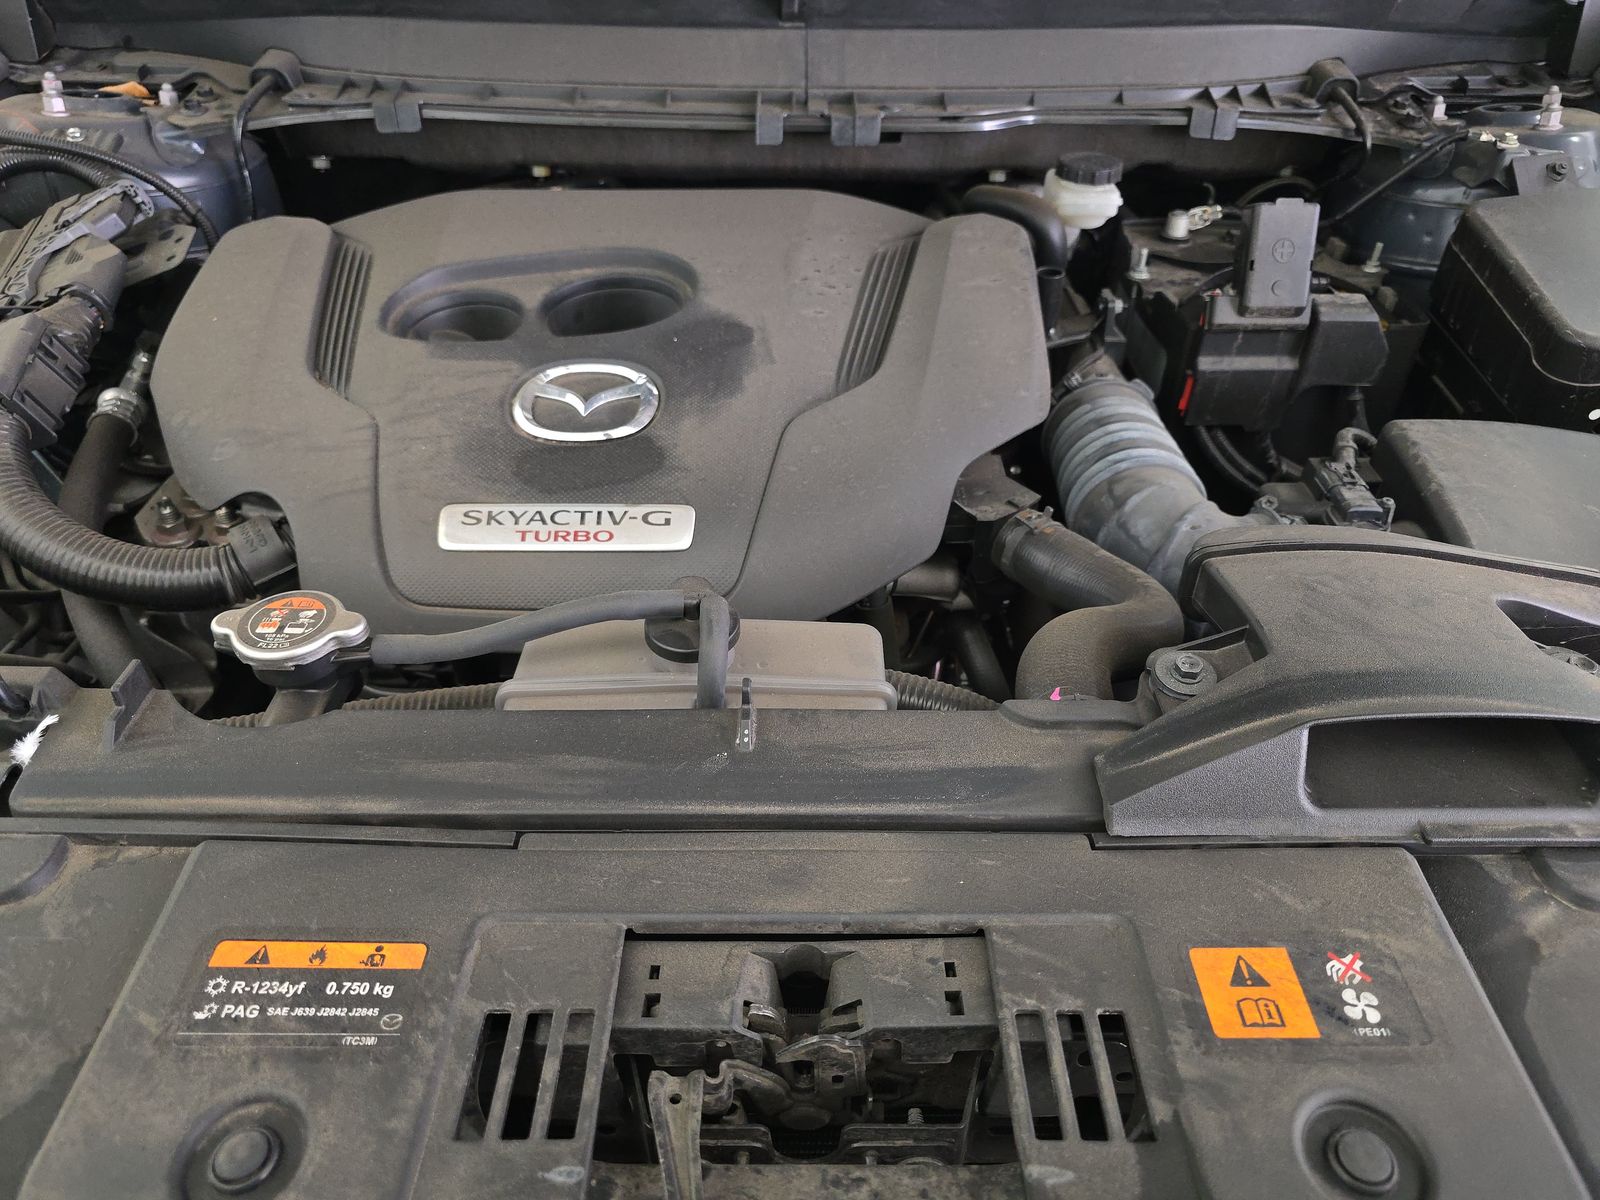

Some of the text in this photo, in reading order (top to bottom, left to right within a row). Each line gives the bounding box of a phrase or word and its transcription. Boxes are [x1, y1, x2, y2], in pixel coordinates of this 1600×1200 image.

[461, 509, 672, 527] SKYACTIV-G
[514, 530, 614, 542] TURBO
[231, 981, 394, 998] R-1234yf 0.750 kg
[221, 1005, 379, 1018] PAG SAE J639 J2842 J2845
